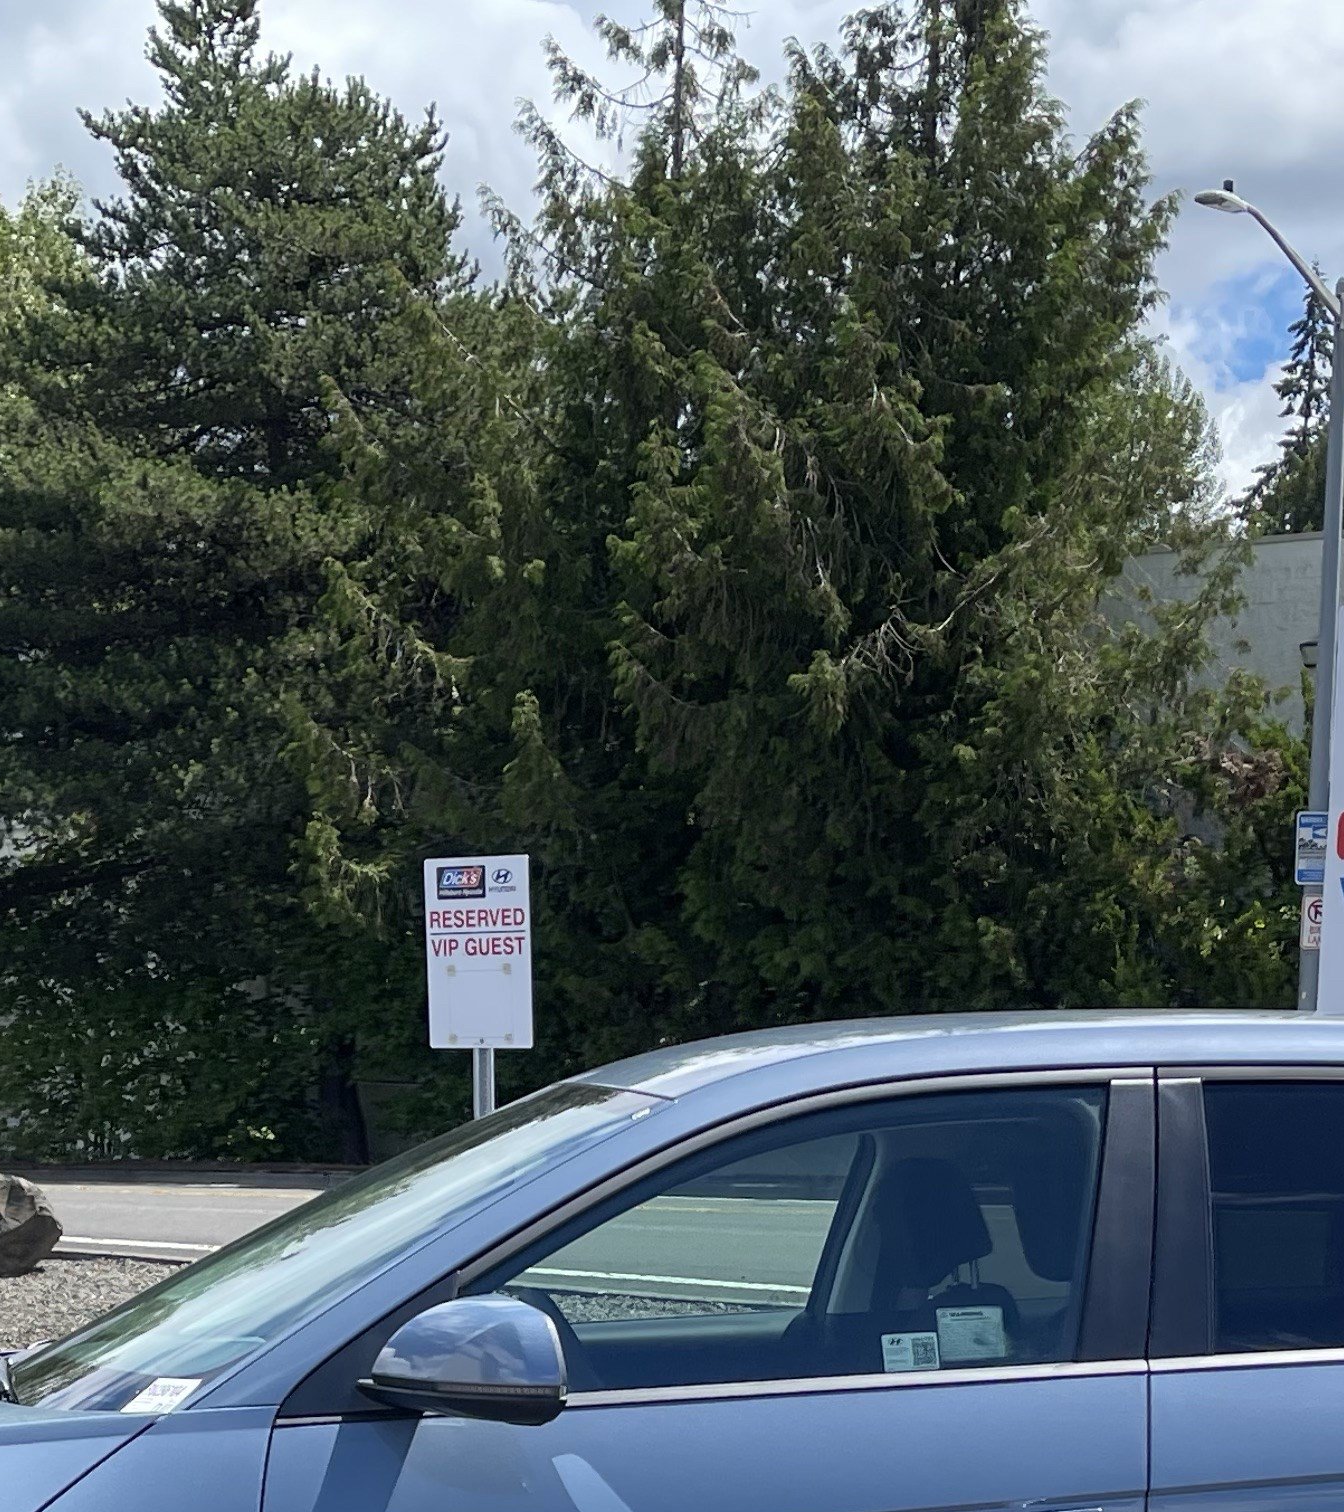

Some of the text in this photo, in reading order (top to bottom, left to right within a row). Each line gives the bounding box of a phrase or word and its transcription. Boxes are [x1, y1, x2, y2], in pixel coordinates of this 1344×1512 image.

[429, 907, 525, 929] RESERVED
[431, 936, 525, 957] VIP GUEST
